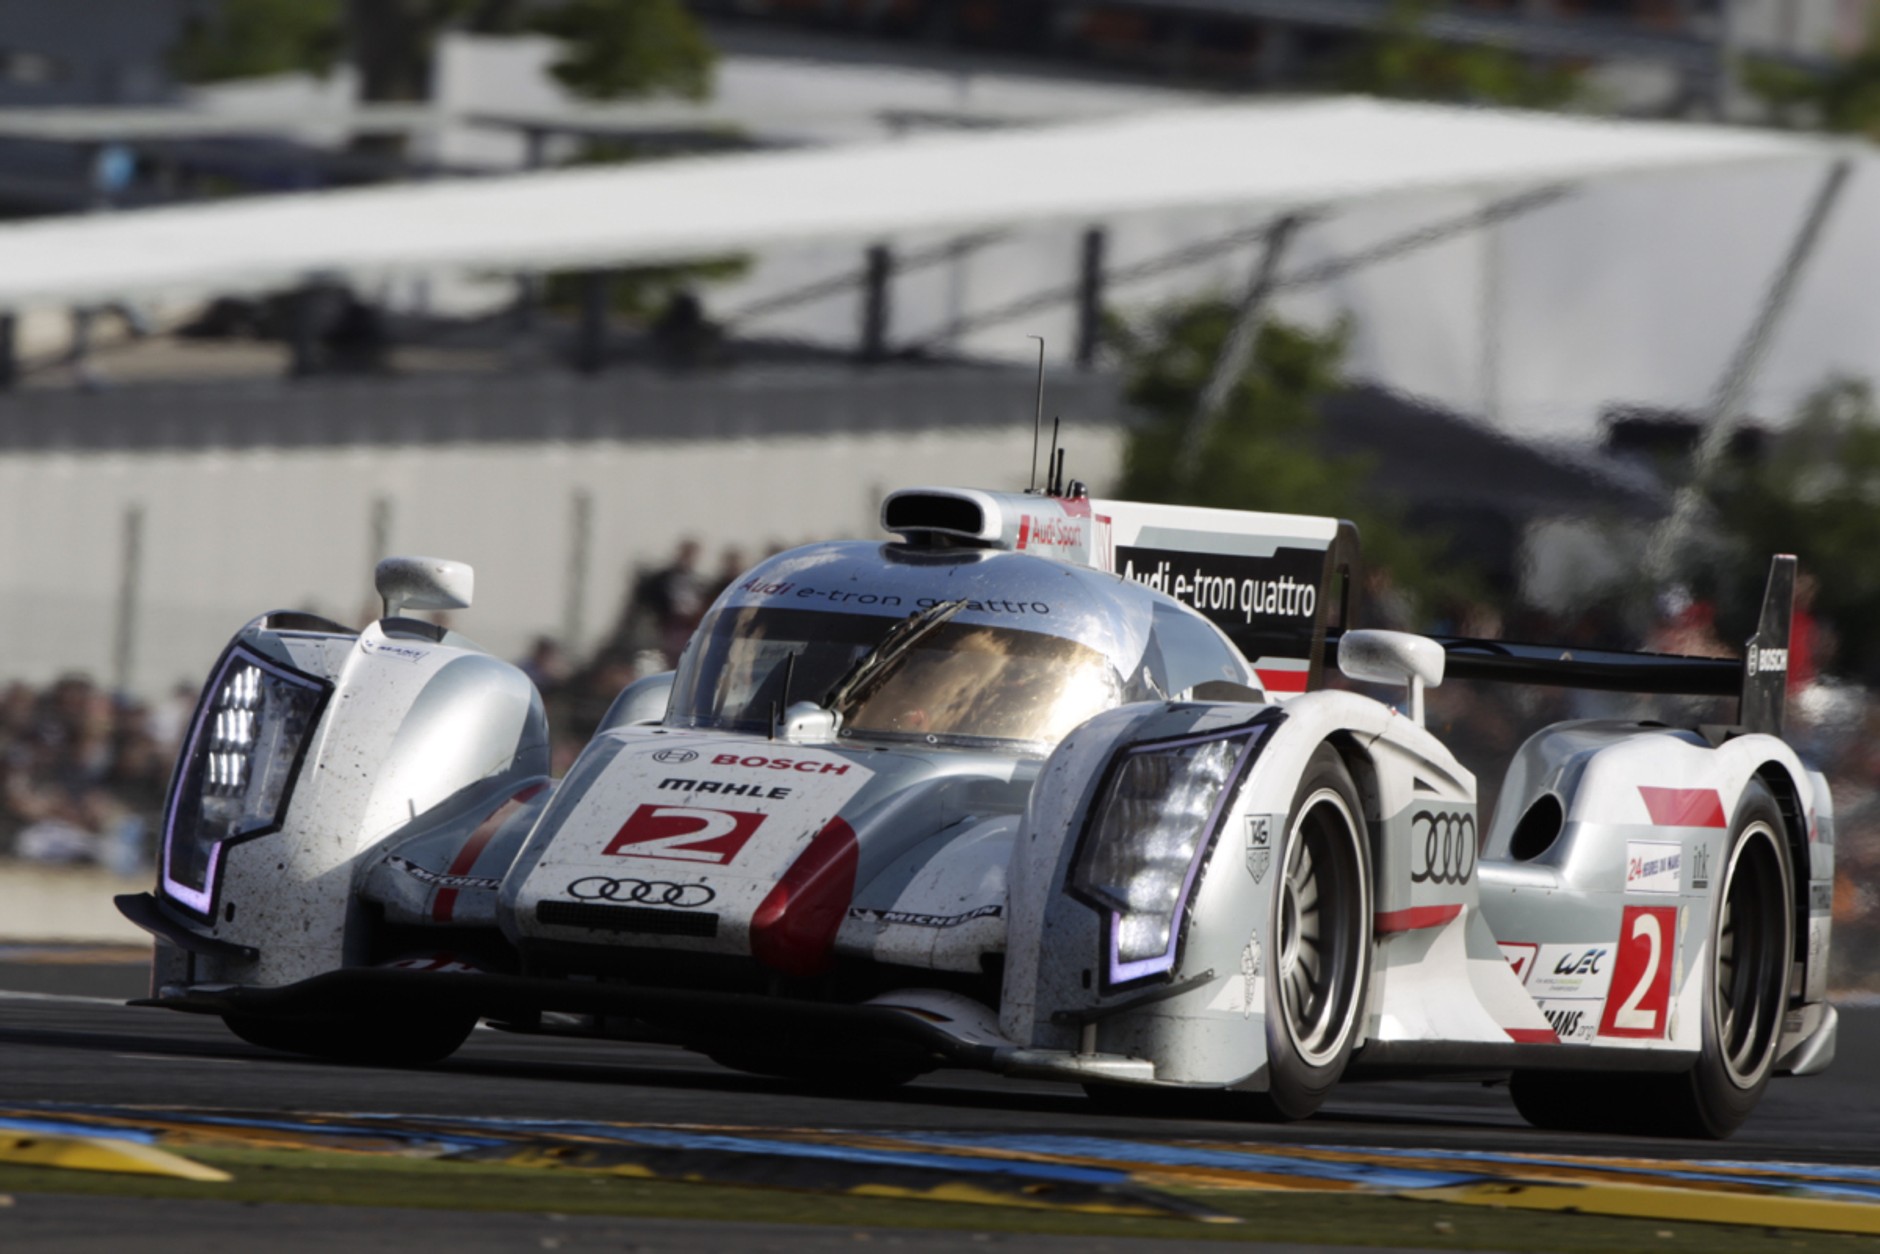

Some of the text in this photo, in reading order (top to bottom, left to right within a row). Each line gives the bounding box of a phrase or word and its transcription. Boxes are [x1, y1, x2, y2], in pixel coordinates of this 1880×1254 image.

[1032, 518, 1082, 552] Audi Sport
[739, 576, 1050, 615] Audi e-tron qattro
[1174, 568, 1236, 610] e-tron
[1241, 575, 1316, 624] quattro
[711, 754, 850, 775] BOSCH
[658, 778, 793, 800] MAHLE
[616, 808, 738, 863] 2
[883, 907, 998, 925] MICHELIN
[1553, 949, 1607, 975] WEC
[1613, 913, 1661, 1029] 2
